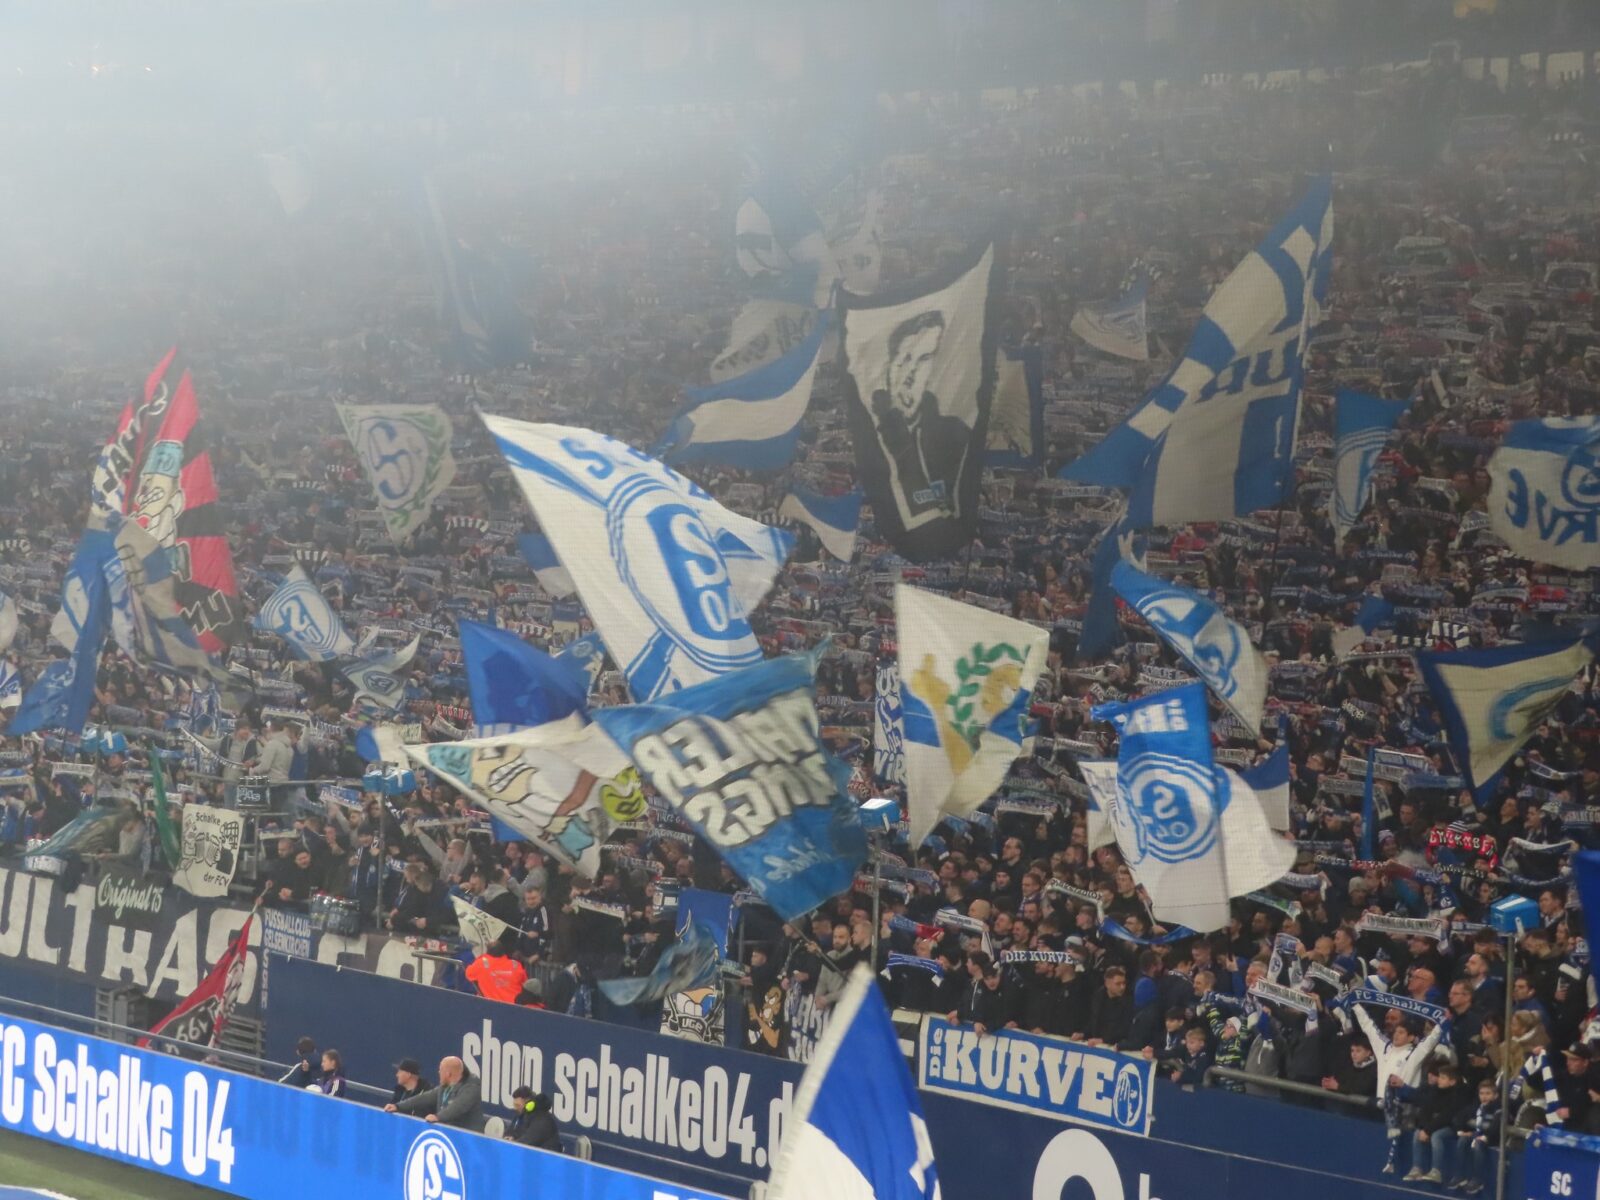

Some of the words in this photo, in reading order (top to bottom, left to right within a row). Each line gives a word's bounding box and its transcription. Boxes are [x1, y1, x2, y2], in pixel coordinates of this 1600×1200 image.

[1006, 949, 1027, 963] DIE
[1030, 950, 1074, 965] KURVE
[1354, 988, 1372, 1000] FC
[1375, 993, 1430, 1015] Schalke
[942, 1029, 1117, 1118] KURVE
[0, 1023, 26, 1124] C
[32, 1032, 174, 1167] Schalke
[182, 1070, 235, 1184] 04
[1550, 1170, 1572, 1196] SC
